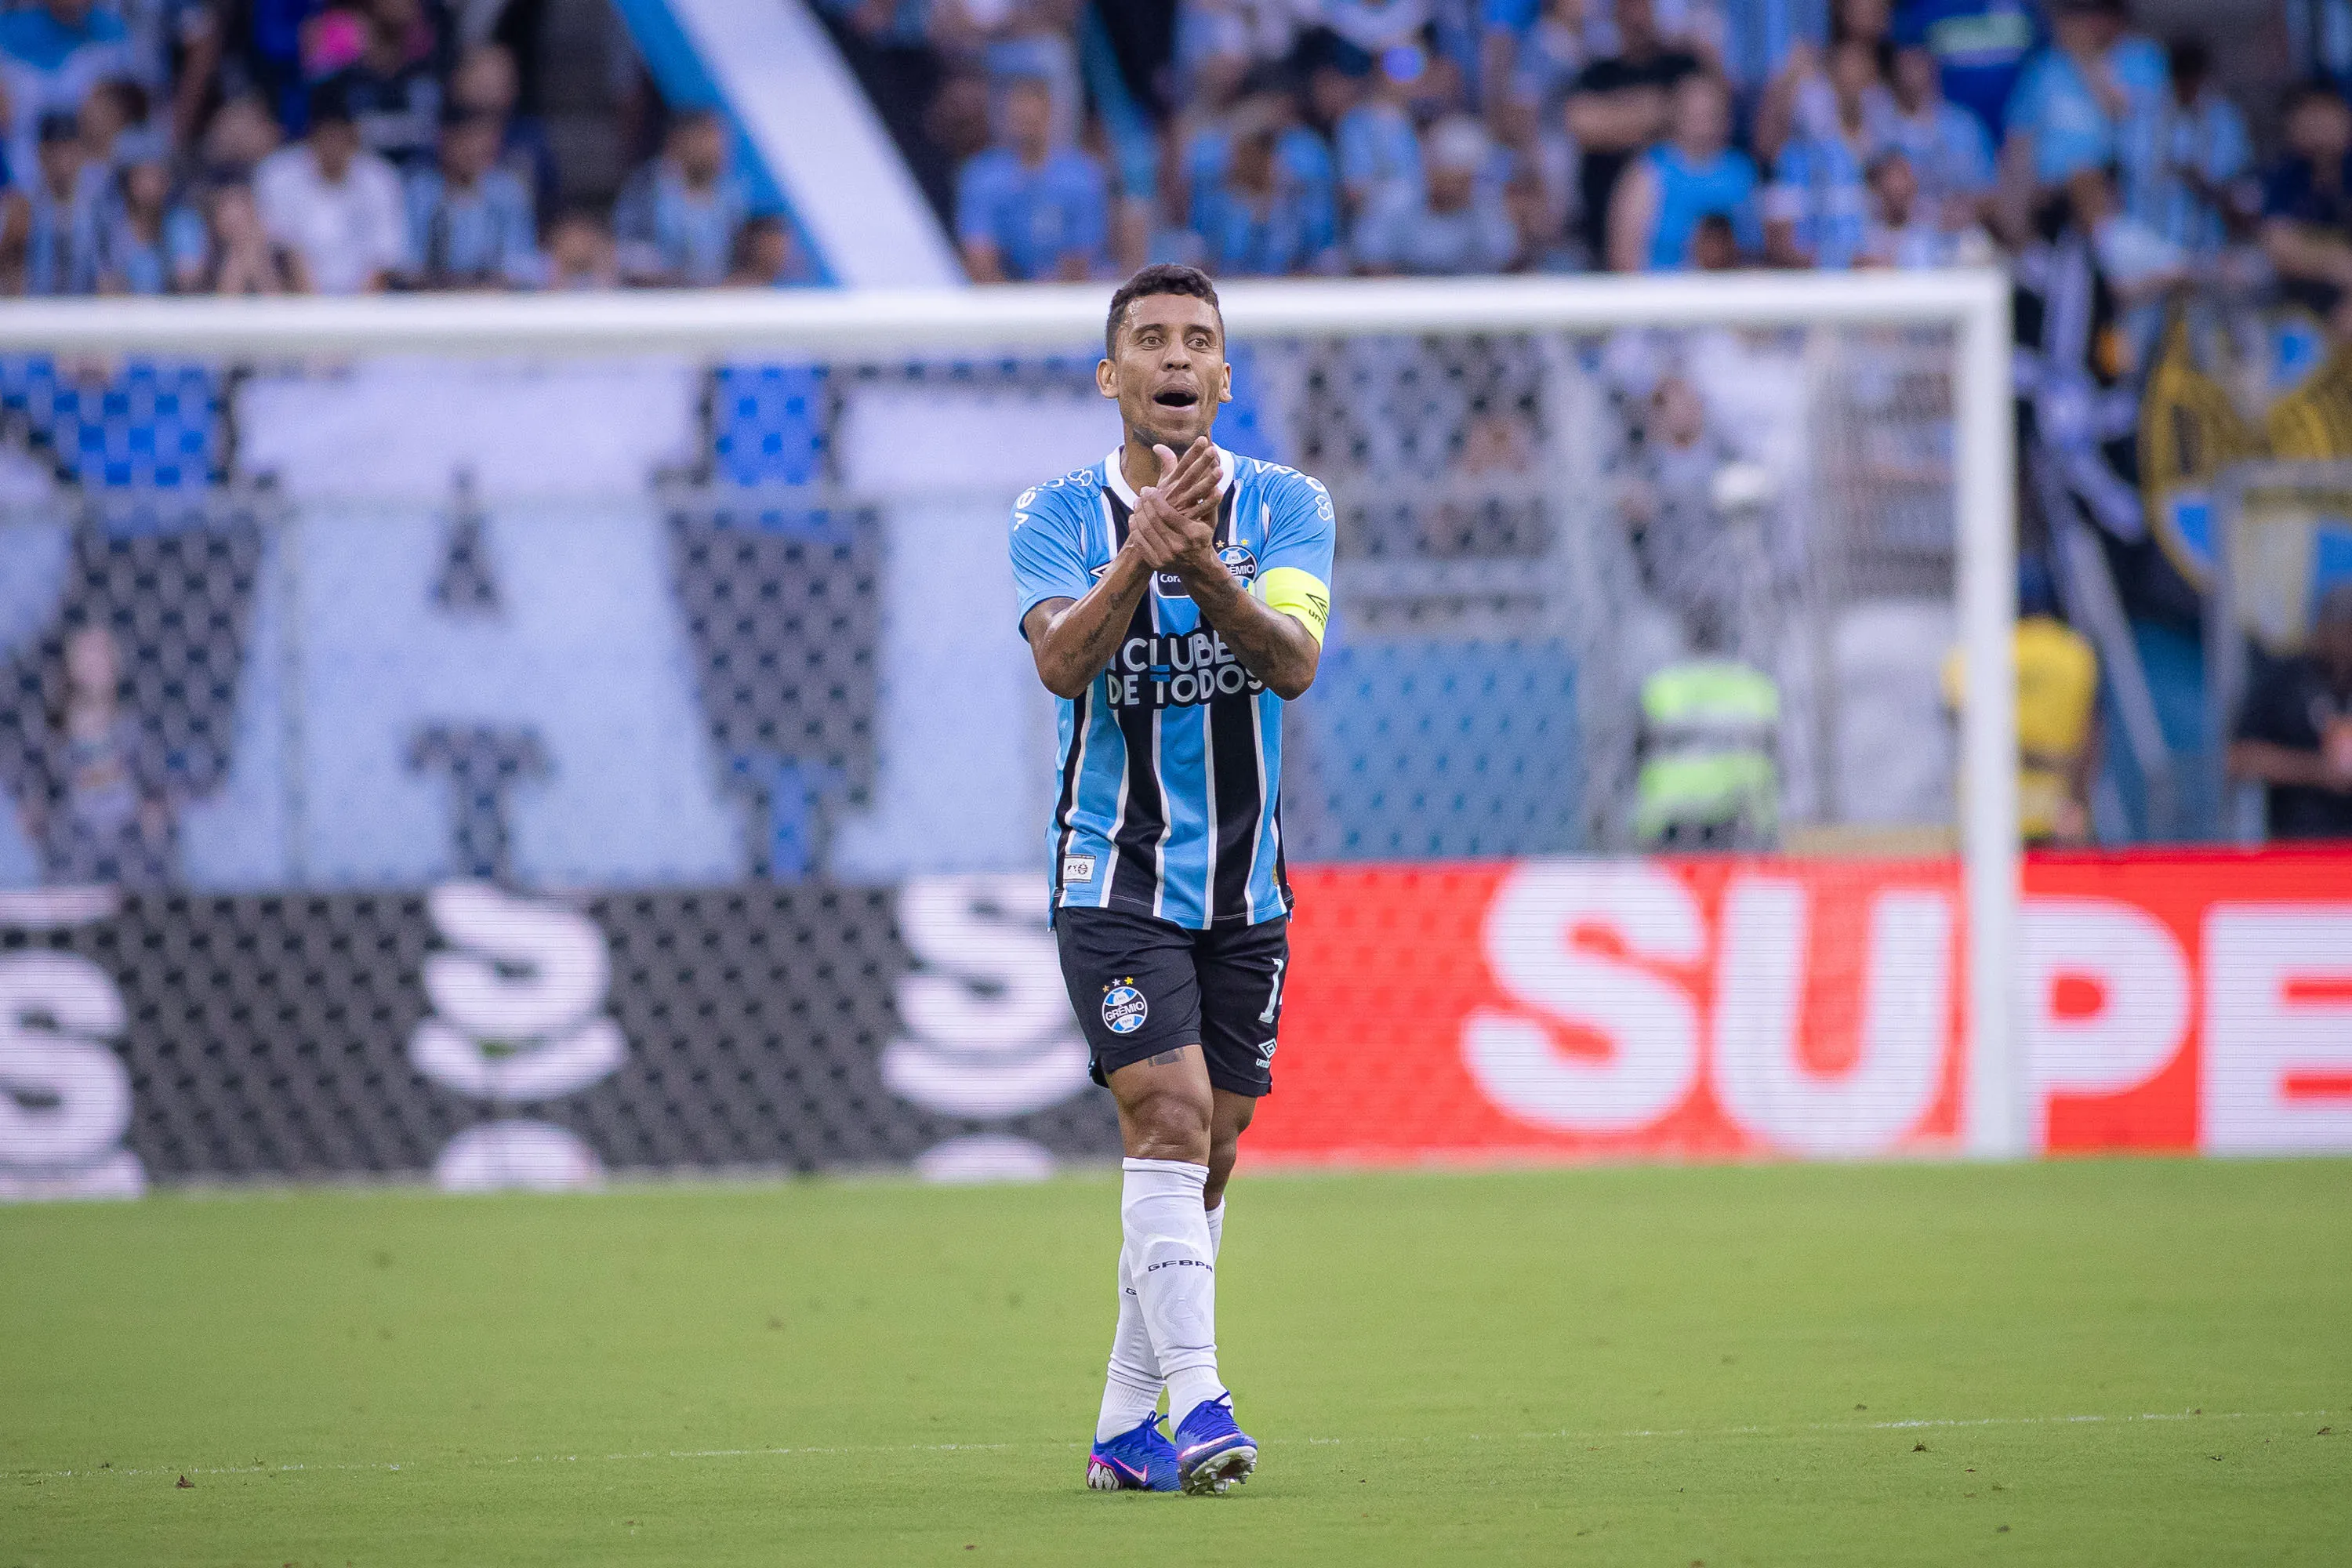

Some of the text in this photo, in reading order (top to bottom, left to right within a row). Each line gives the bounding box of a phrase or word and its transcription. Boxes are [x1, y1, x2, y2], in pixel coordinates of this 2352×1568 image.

[1123, 630, 1236, 672] CLUBE
[1107, 673, 1140, 706] DE
[1105, 1001, 1145, 1021] GRÊMIO
[1461, 853, 2352, 1162] SUPE
